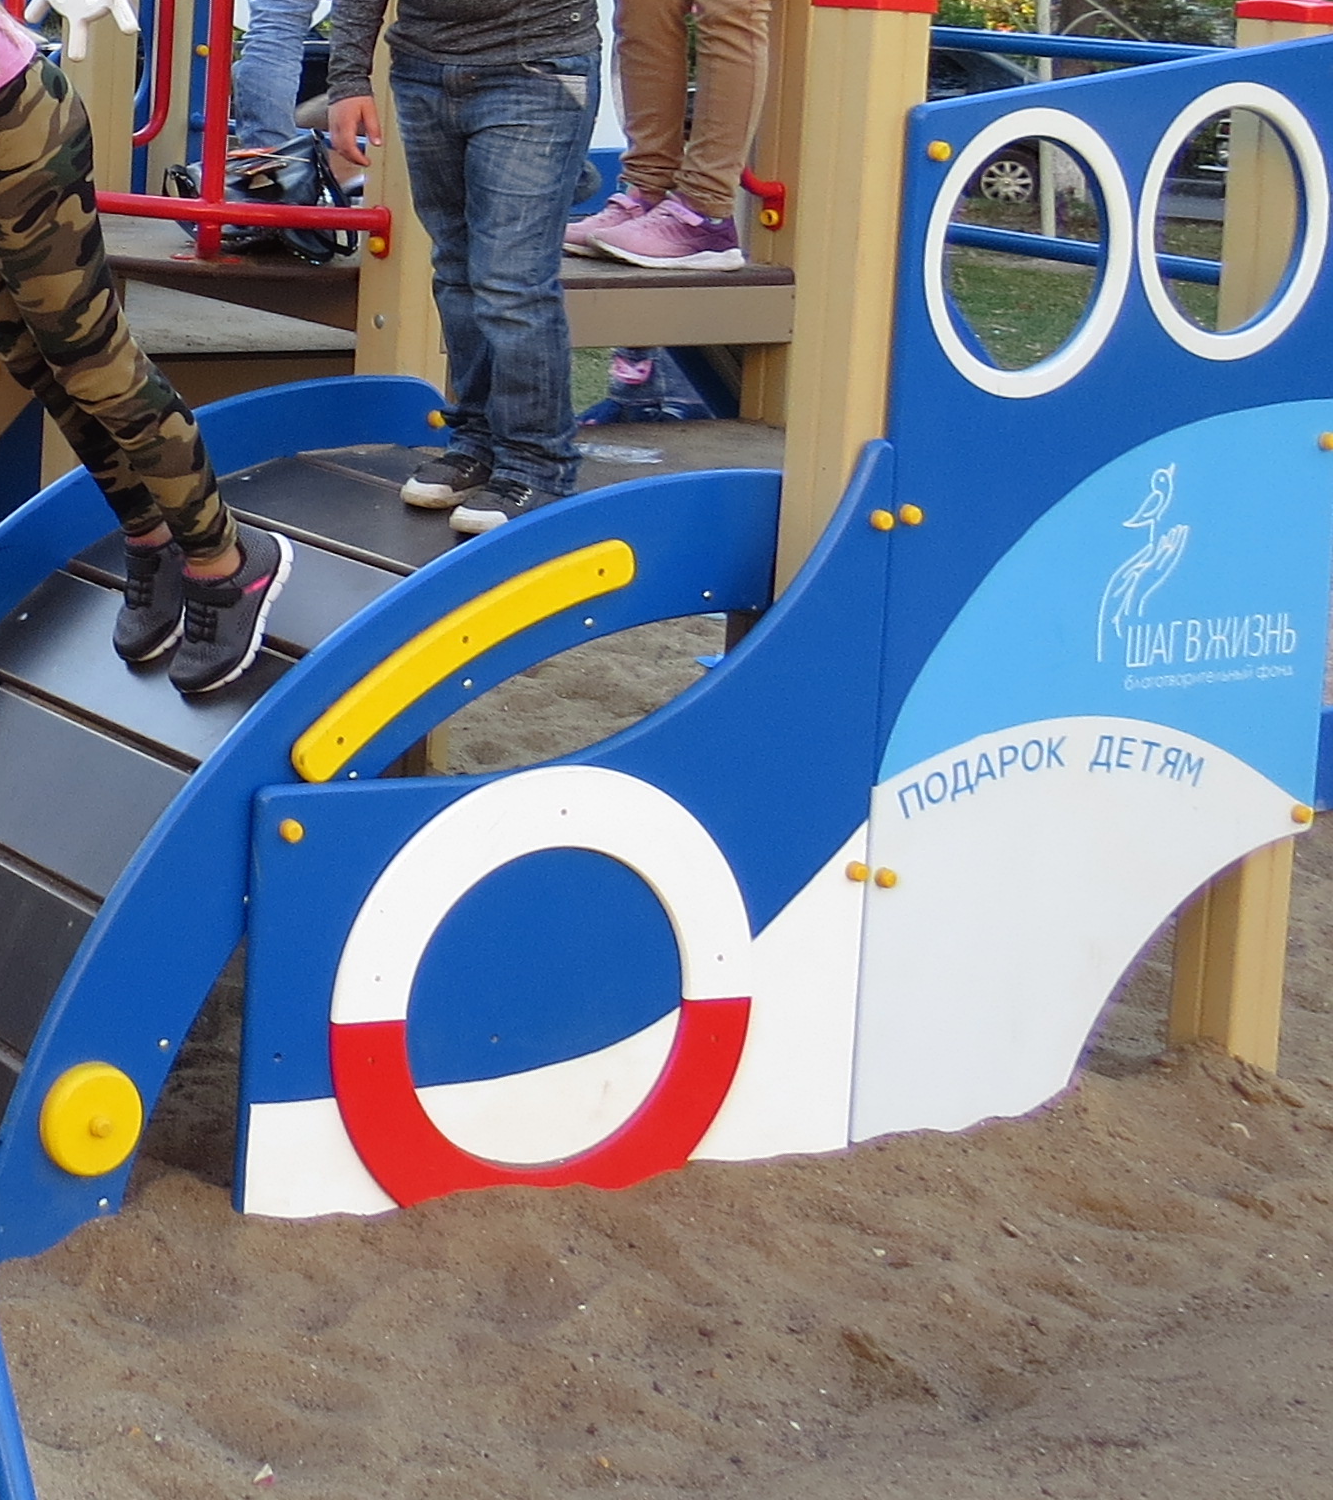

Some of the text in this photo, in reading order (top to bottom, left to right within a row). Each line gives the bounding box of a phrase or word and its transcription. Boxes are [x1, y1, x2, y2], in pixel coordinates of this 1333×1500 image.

[1125, 612, 1297, 668] ШАГ В ЖИЗНЬ
[897, 734, 1206, 820] ПОДАРОК ДЕТЯМ
